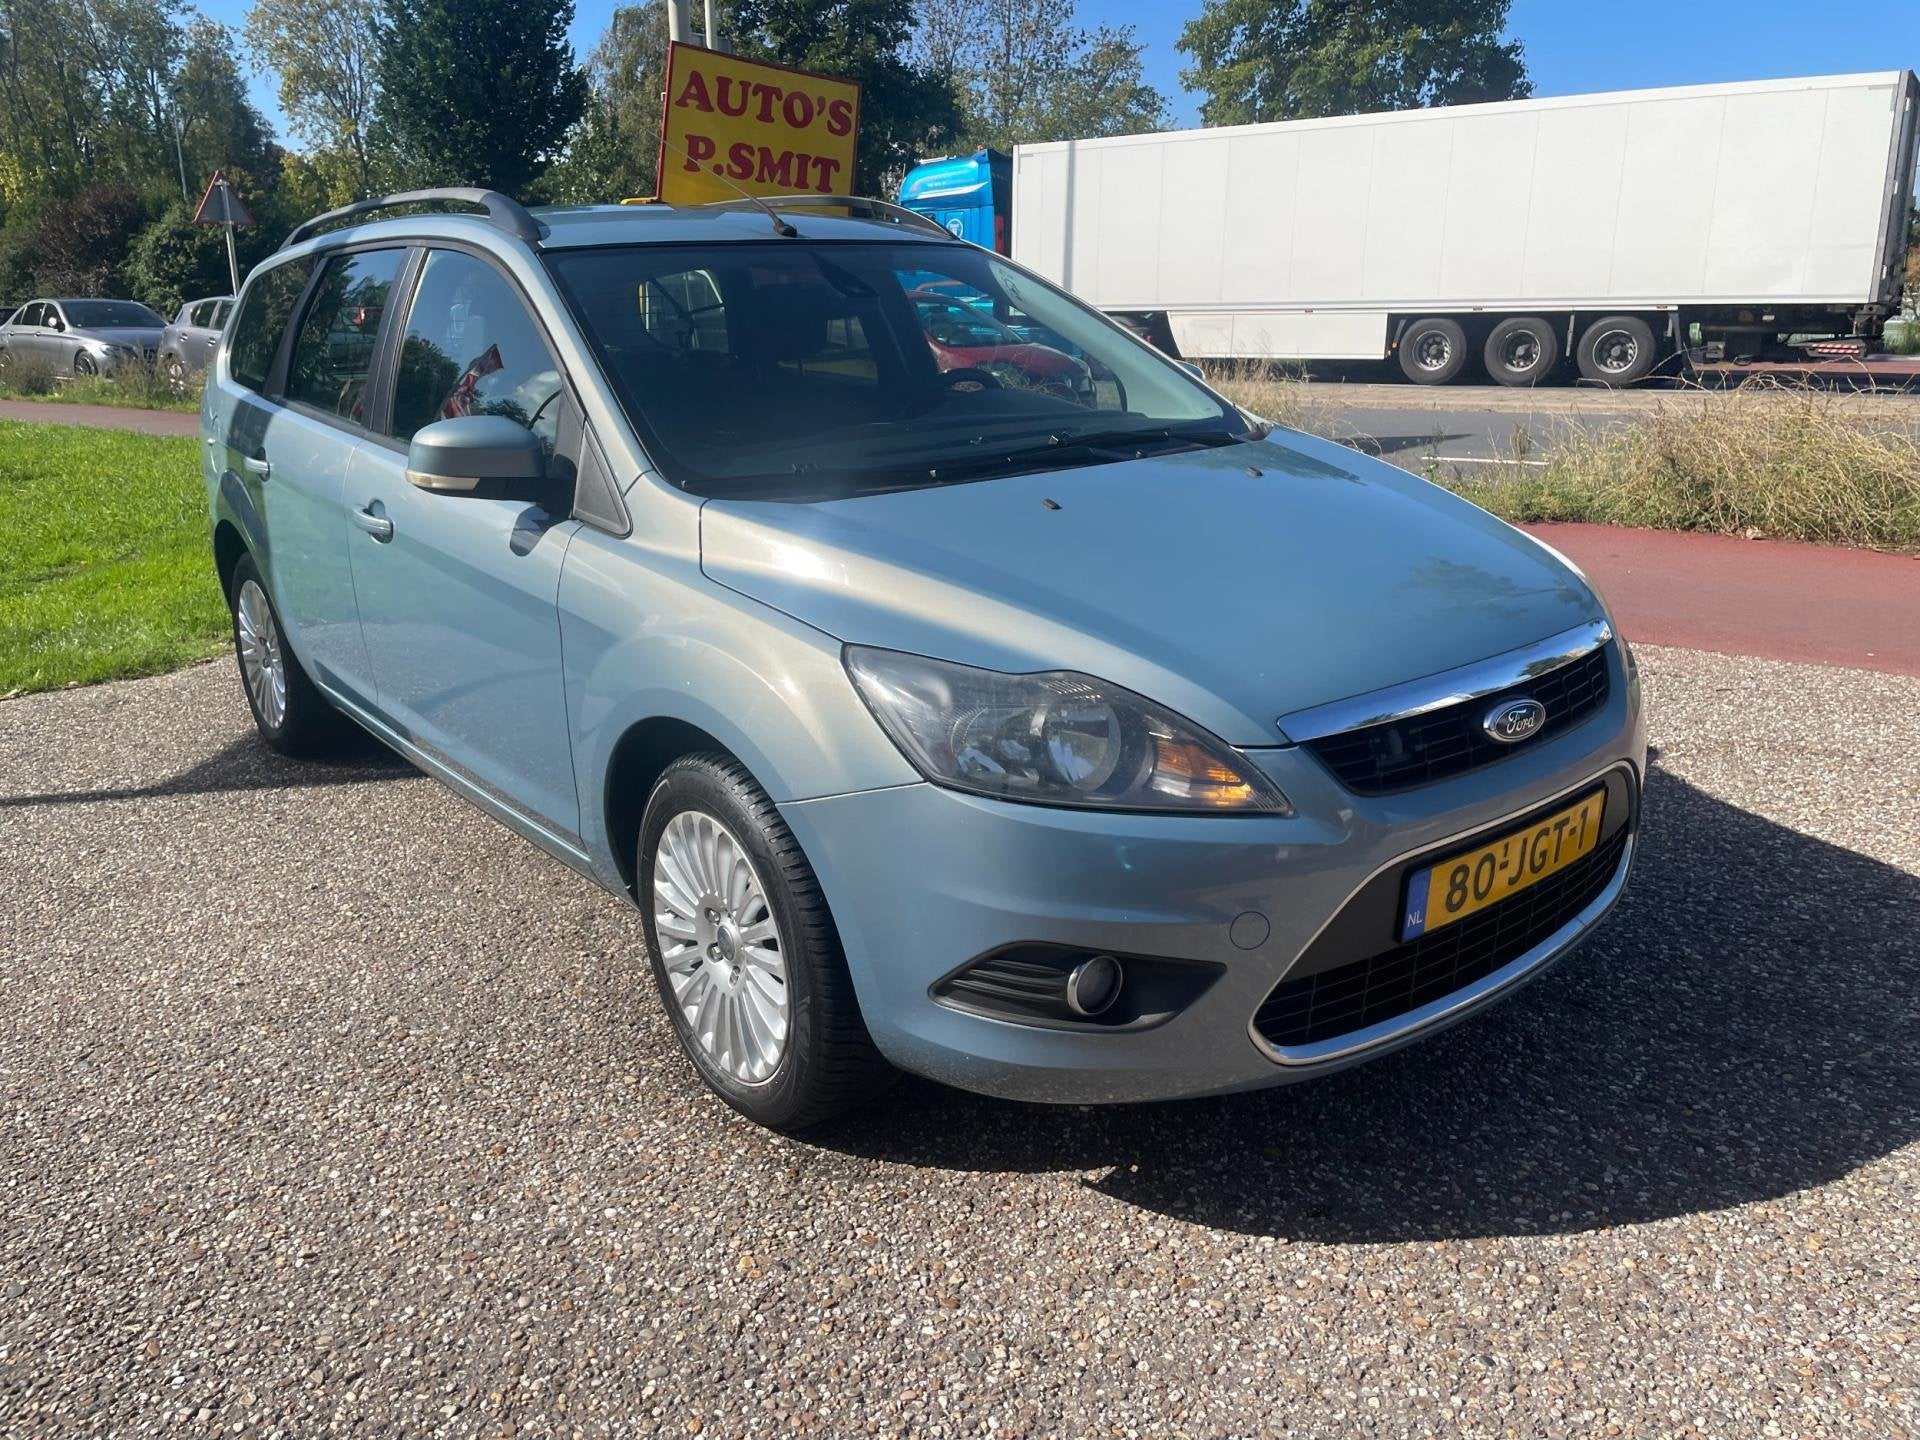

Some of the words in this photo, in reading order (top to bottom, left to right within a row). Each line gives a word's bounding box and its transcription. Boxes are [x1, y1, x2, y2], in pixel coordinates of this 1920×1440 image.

[675, 70, 853, 137] AUTO'S
[683, 134, 841, 194] P.SMIT
[1506, 708, 1536, 734] Ford
[1445, 805, 1589, 913] 80-JGT-1
[1407, 910, 1423, 928] NL
